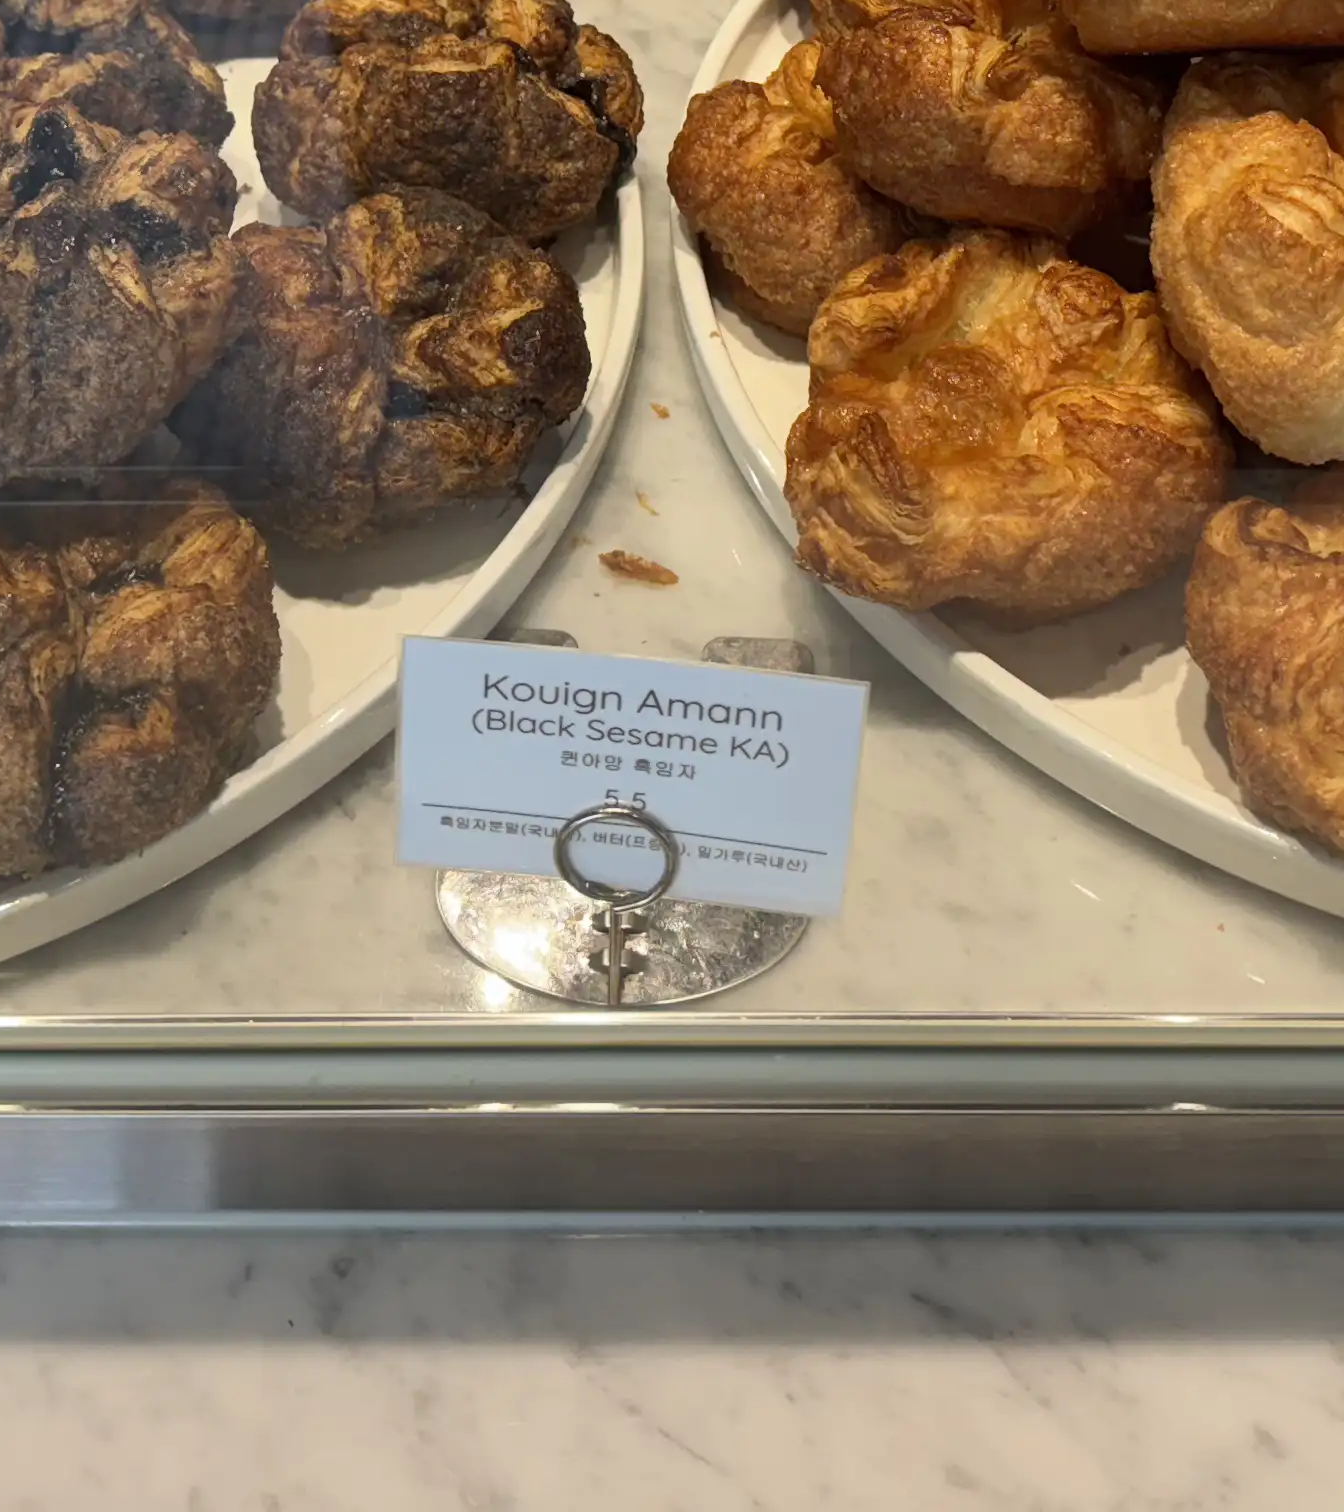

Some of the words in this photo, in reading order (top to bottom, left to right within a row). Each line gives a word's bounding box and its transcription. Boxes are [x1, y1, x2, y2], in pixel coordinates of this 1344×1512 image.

[482, 674, 624, 715] Kouign
[636, 689, 783, 733] Amann
[471, 708, 575, 741] (Black
[586, 720, 718, 754] Sesame
[729, 736, 789, 768] KA)
[633, 757, 698, 781] 흑임자
[603, 789, 647, 812] 55
